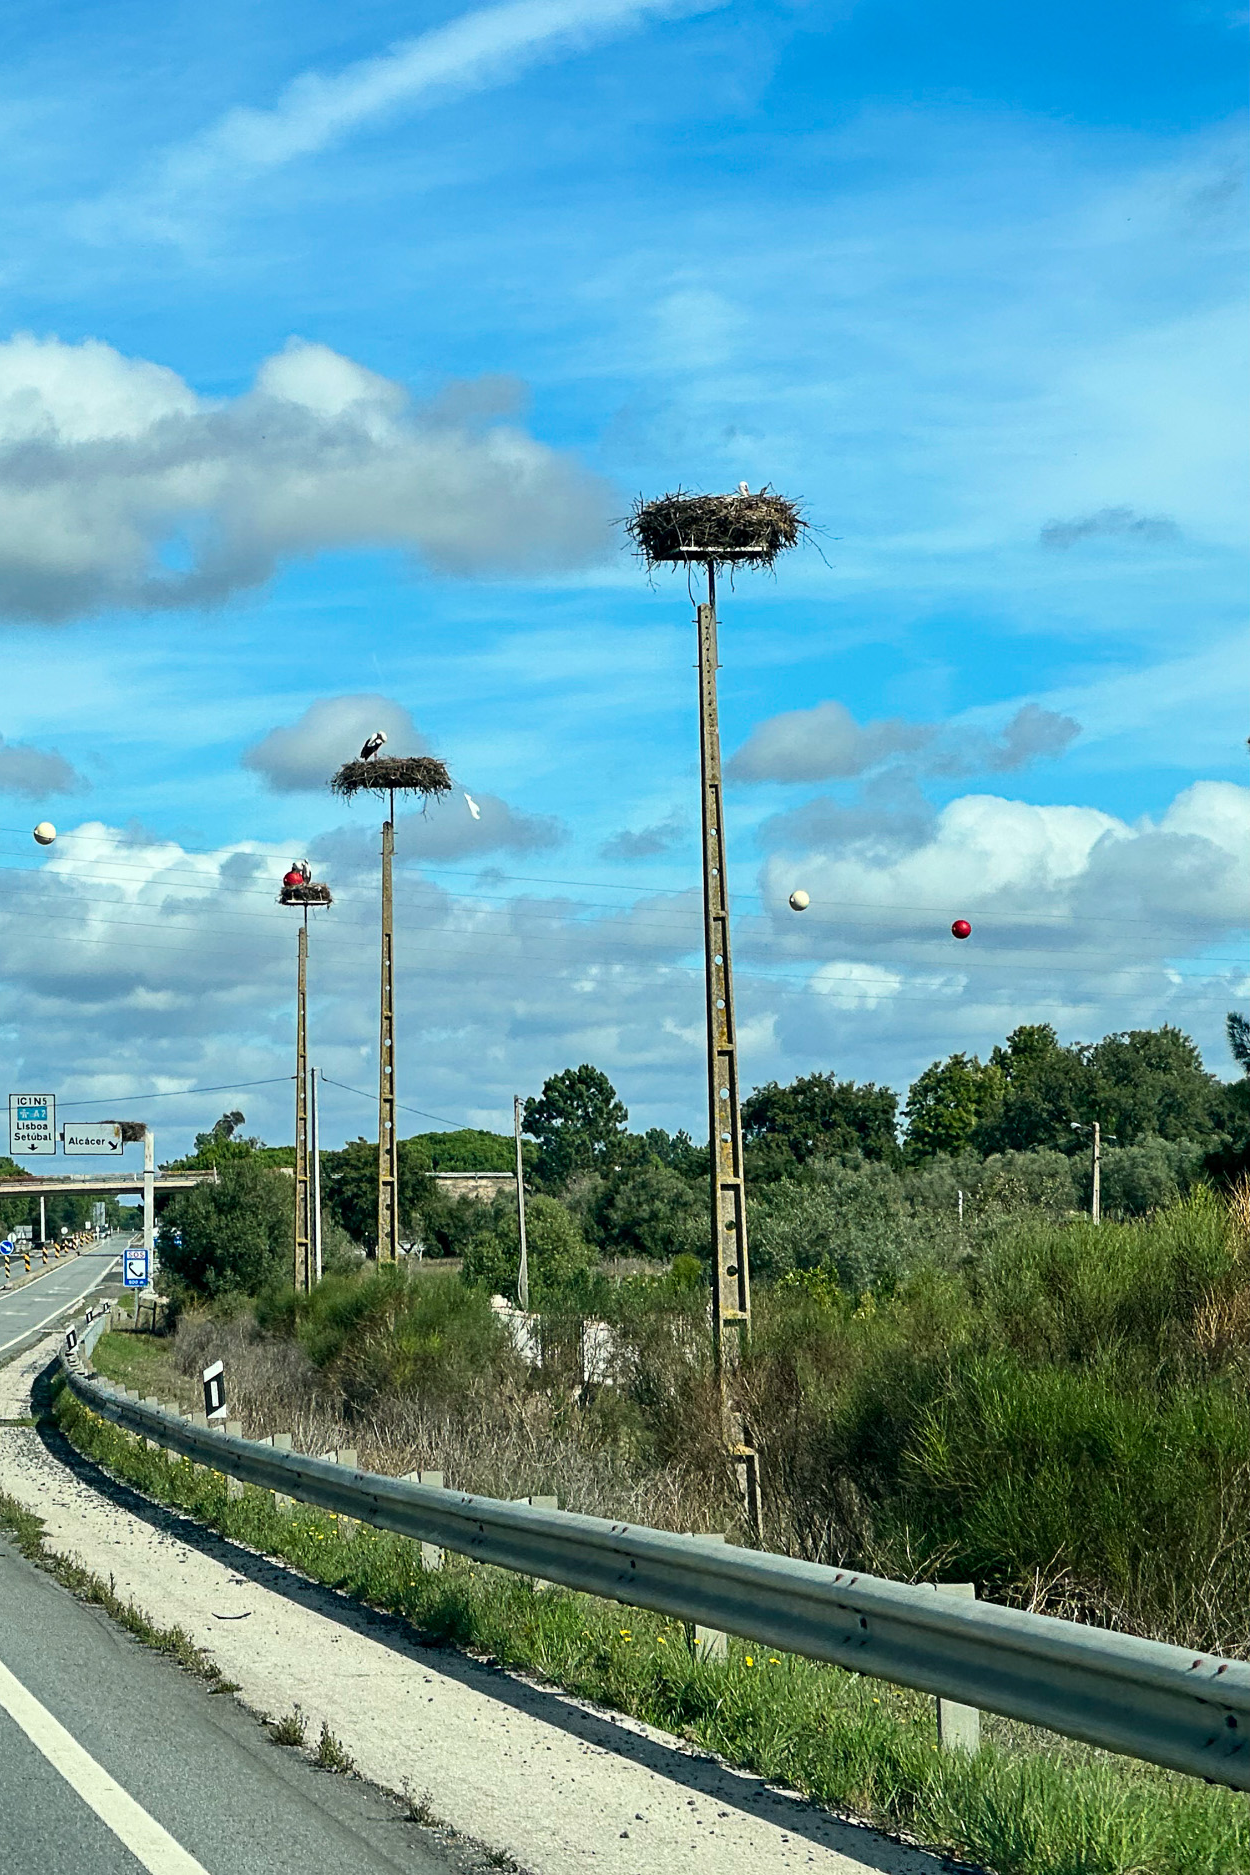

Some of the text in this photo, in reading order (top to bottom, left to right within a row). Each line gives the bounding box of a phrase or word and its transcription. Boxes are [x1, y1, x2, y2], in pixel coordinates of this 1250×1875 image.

[17, 1122, 48, 1130] Lisboa
[14, 1132, 52, 1141] Setúbal
[68, 1137, 105, 1145] Alcácer
